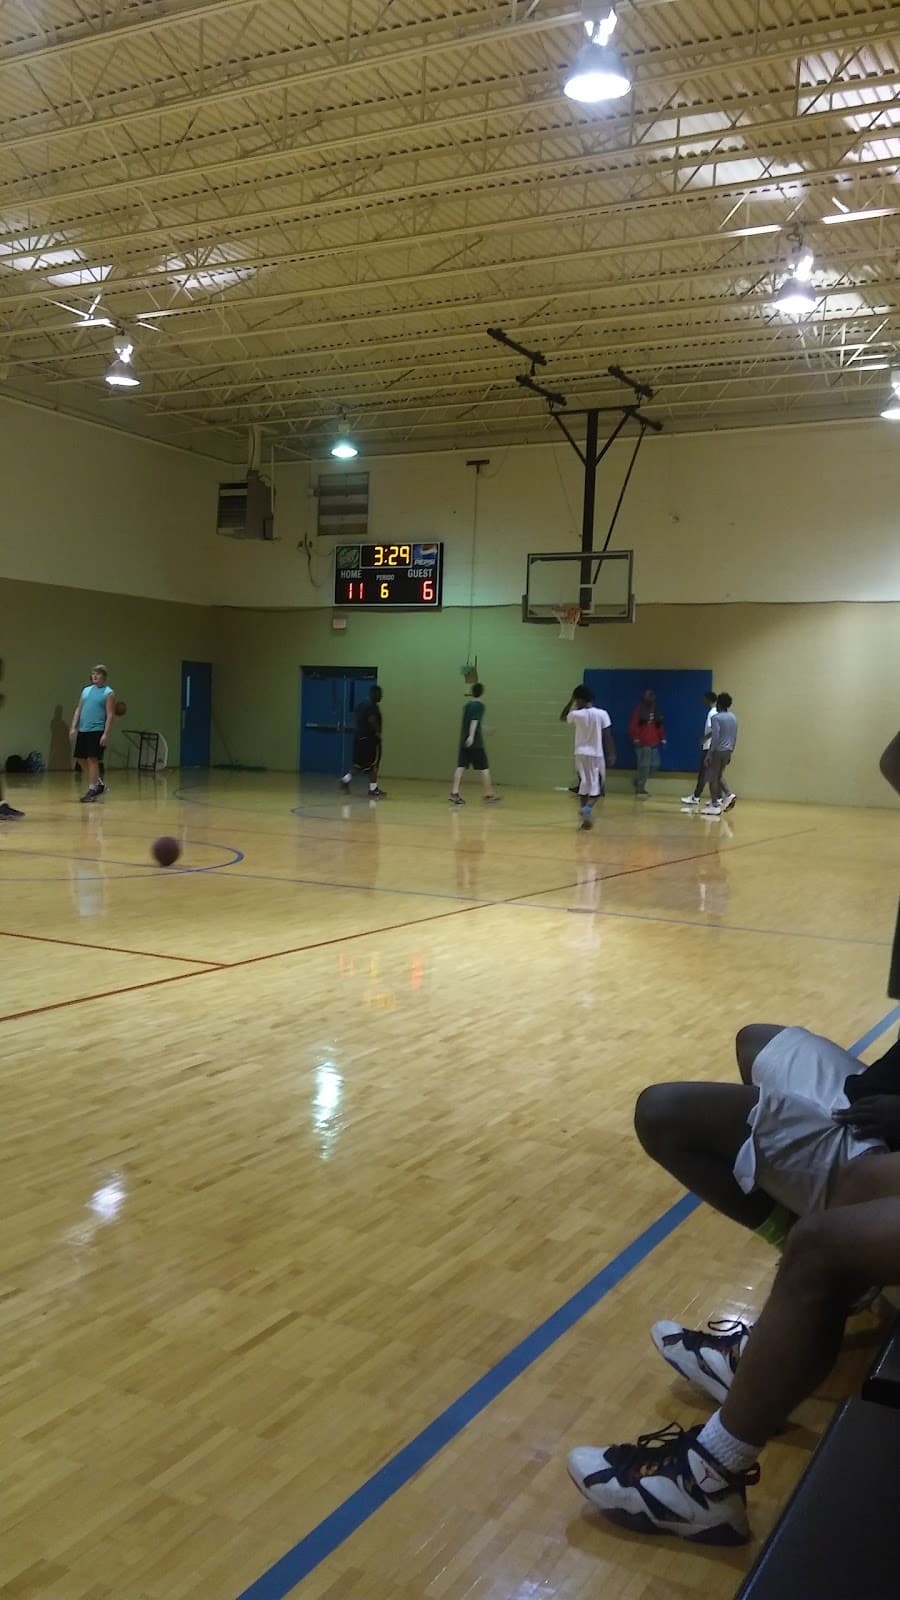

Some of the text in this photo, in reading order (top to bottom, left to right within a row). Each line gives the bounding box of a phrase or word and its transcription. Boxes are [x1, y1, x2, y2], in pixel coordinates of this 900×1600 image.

[374, 545, 410, 566] 3:29
[340, 569, 362, 579] HOME
[407, 568, 433, 578] GUEST
[348, 582, 364, 600] 11
[380, 582, 389, 599] 6
[422, 580, 434, 600] 6
